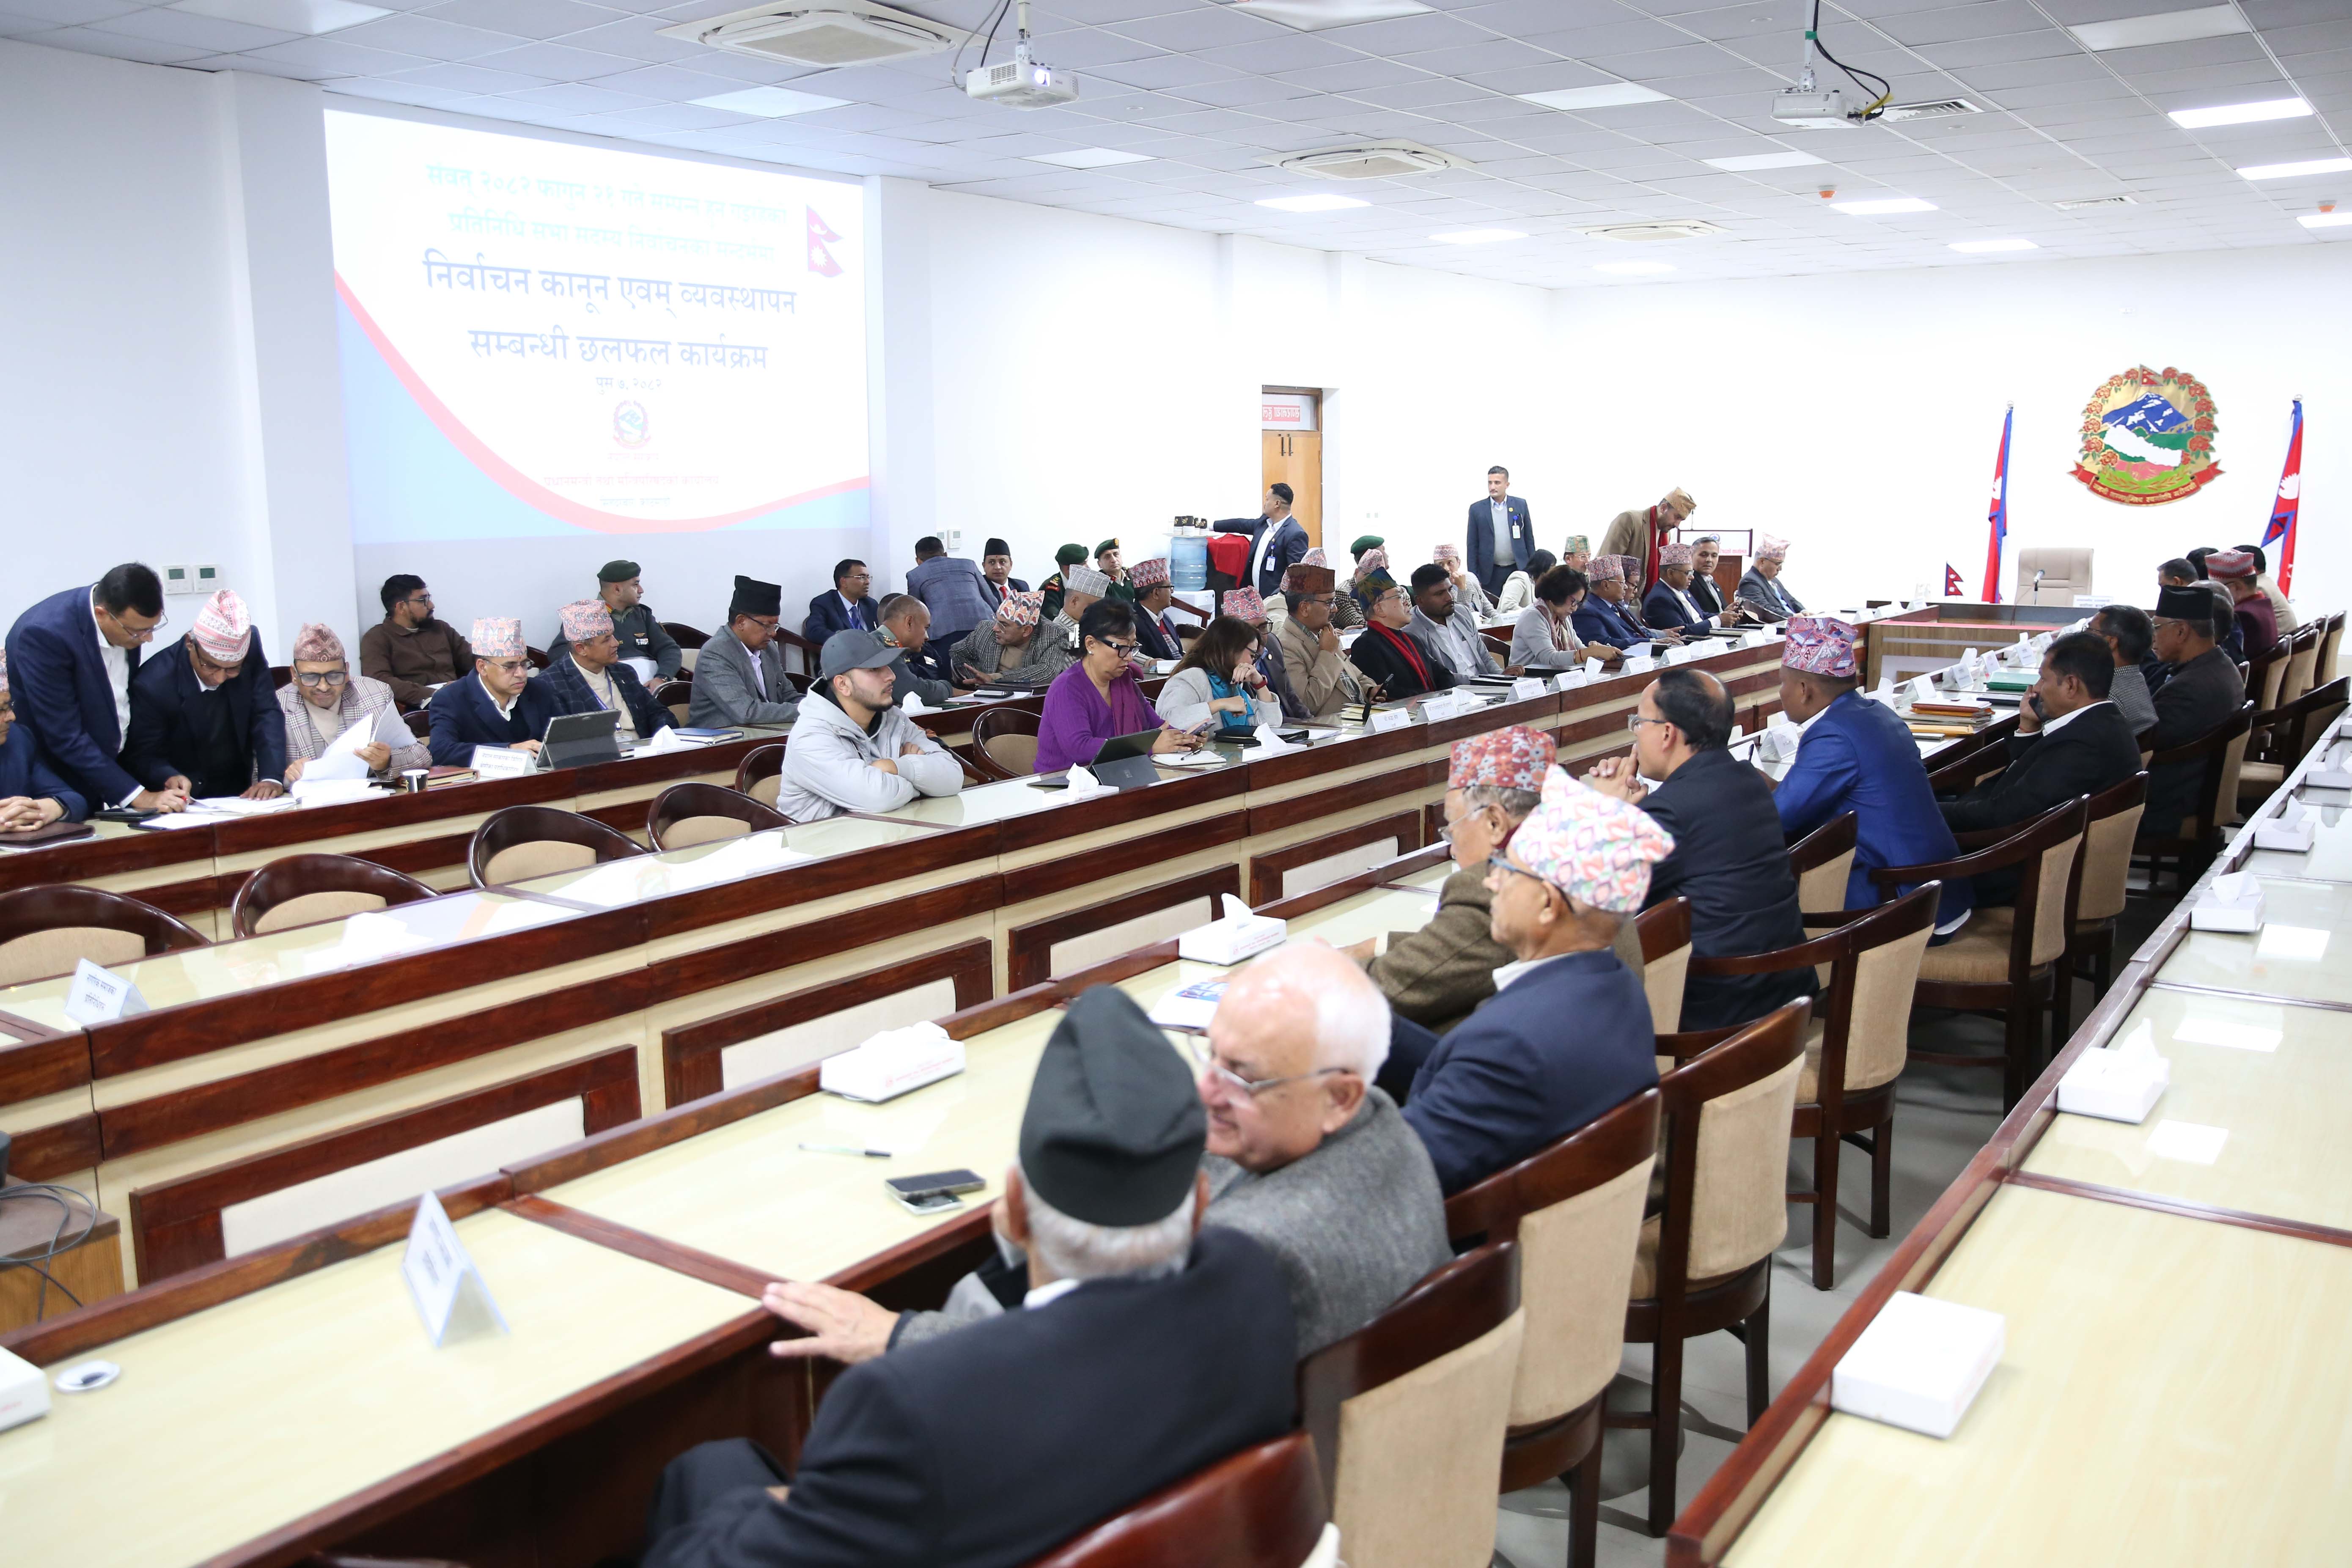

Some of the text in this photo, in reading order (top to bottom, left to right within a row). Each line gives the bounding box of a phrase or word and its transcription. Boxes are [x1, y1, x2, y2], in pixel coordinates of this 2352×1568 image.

[426, 163, 478, 198] संवत्
[481, 170, 530, 196] २०८२
[536, 179, 586, 210] फागुन
[447, 206, 526, 237] प्रतिनिधि
[531, 222, 569, 242] सभा
[423, 248, 797, 319] निर्वाचन कानून एवम् व्यवस्थापन
[468, 325, 767, 369] सम्बन्धी छलफल कार्यक्रम
[596, 377, 614, 395] पुस
[633, 378, 662, 390] २०८२
